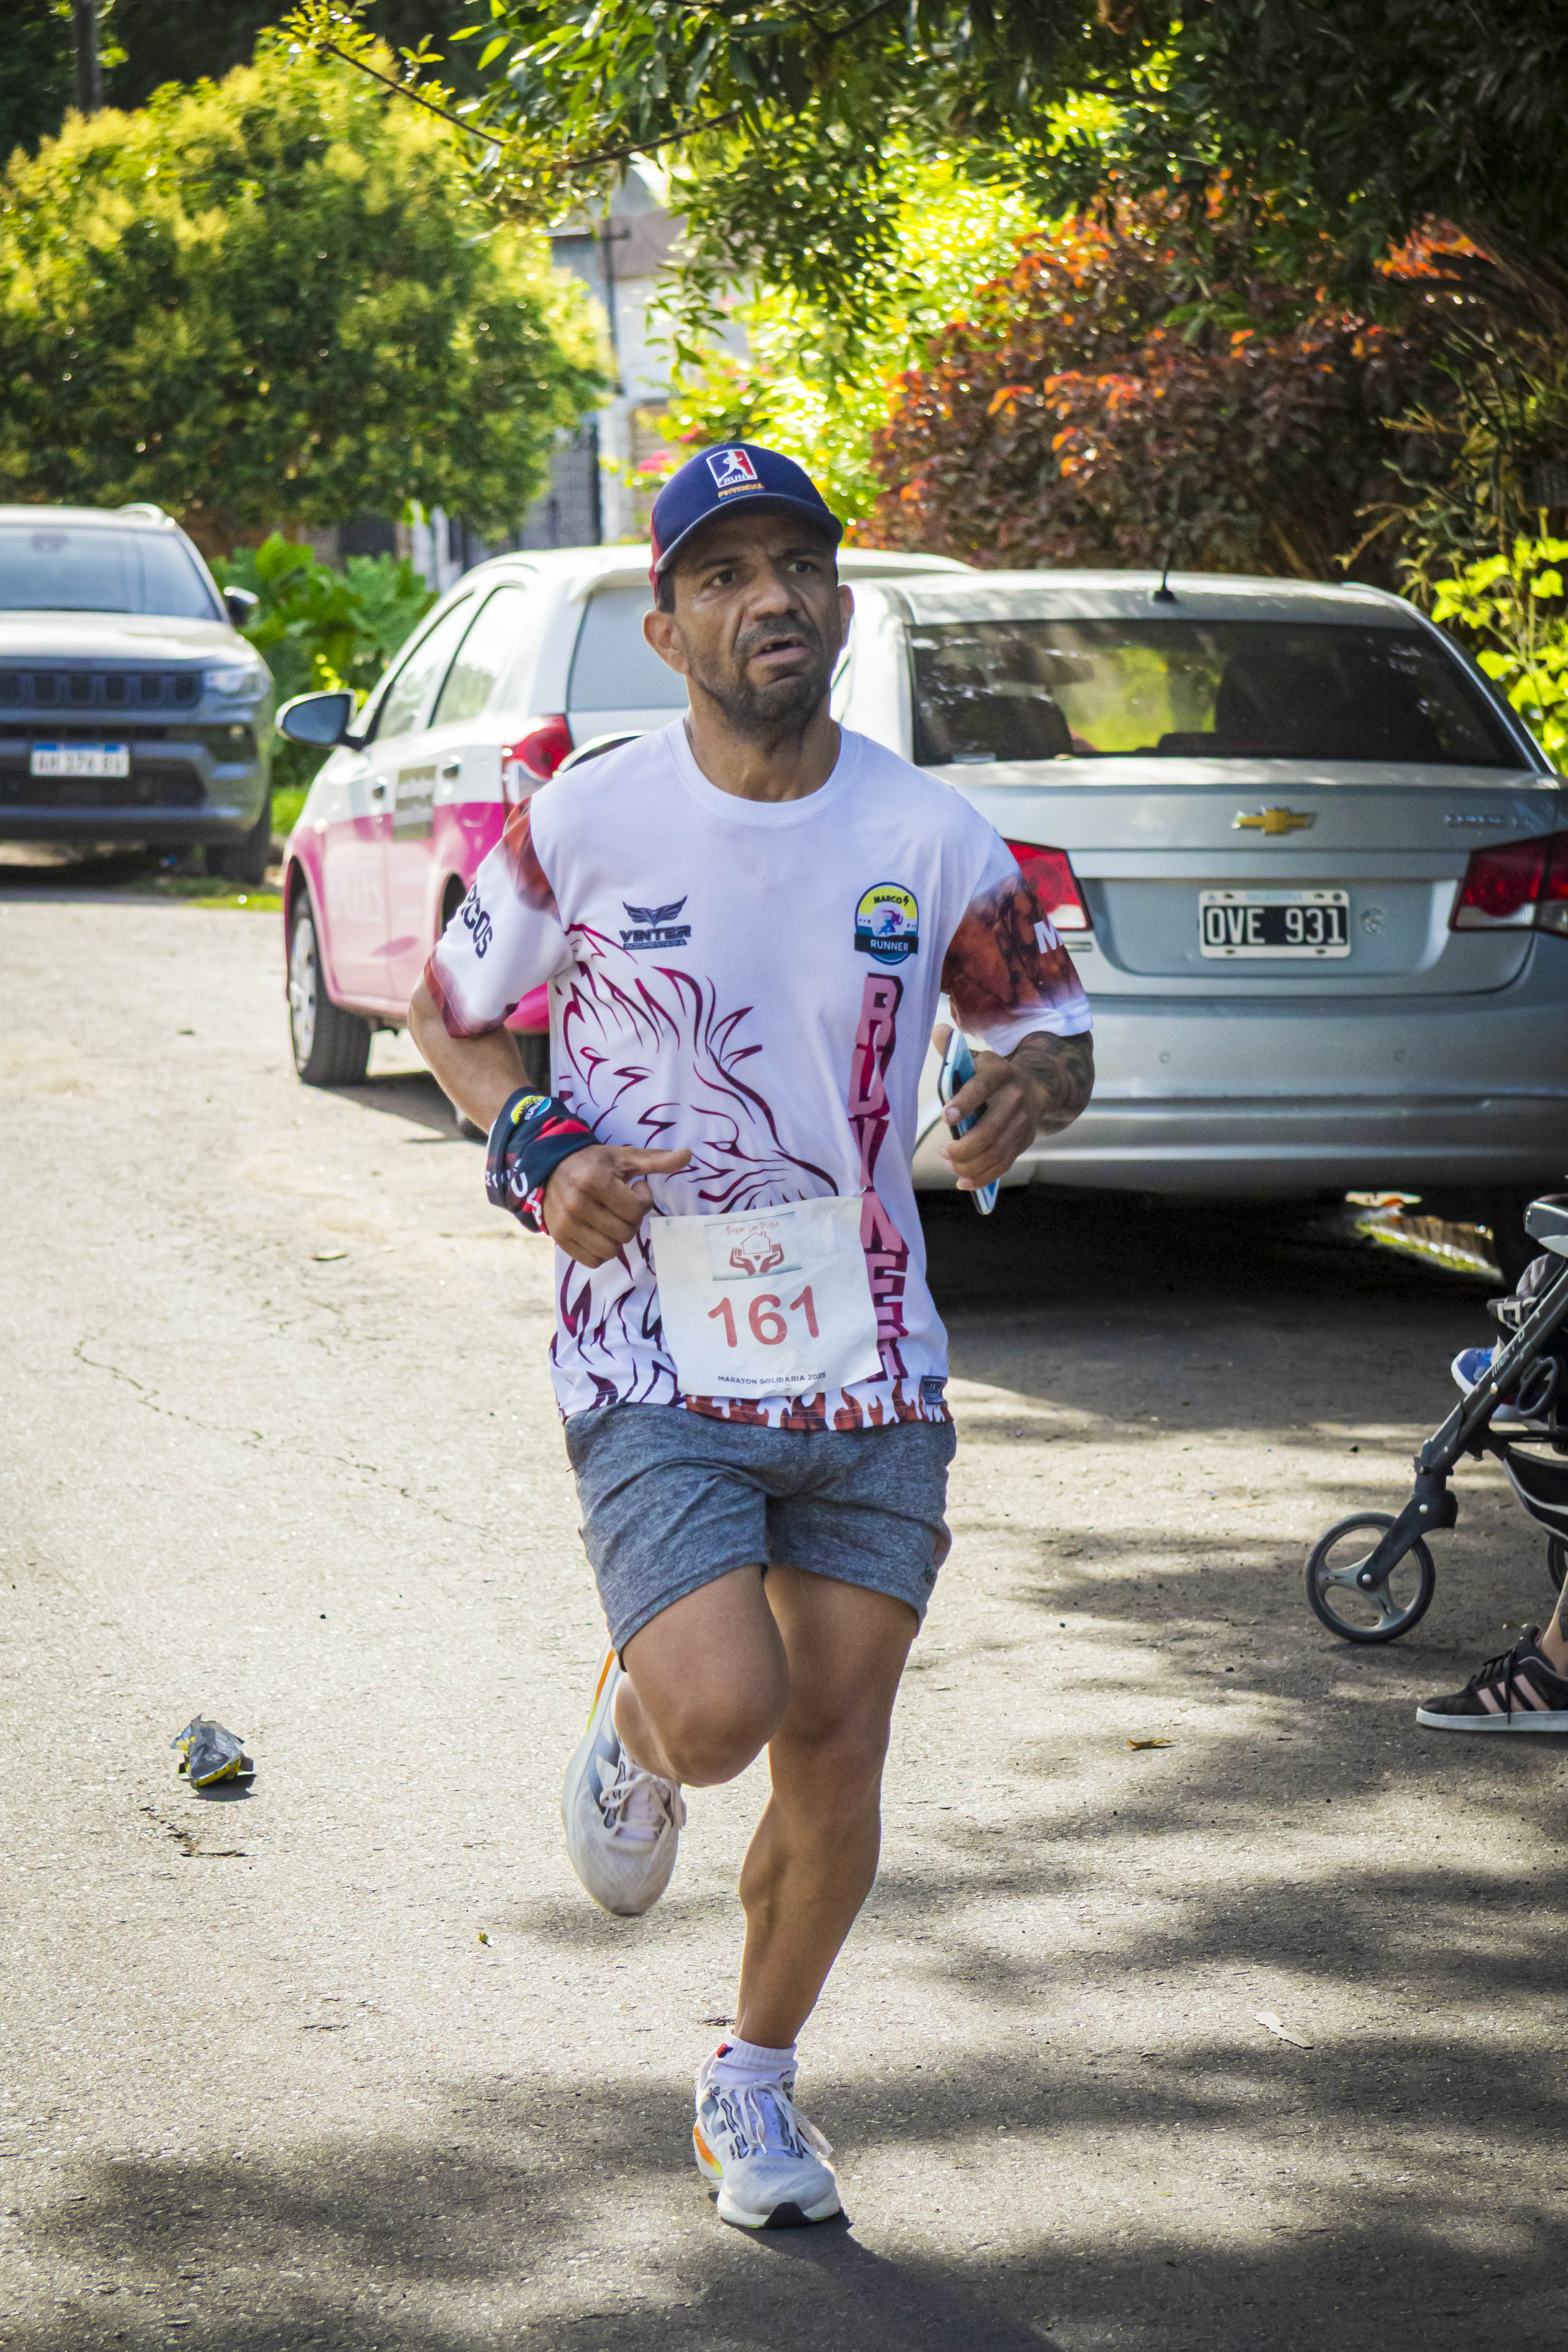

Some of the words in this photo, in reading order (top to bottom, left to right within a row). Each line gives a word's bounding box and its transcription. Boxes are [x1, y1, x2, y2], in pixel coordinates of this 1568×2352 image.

[723, 474, 747, 484] RUN
[619, 925, 691, 943] VINTER
[1206, 908, 1266, 944] OVE
[1285, 908, 1345, 944] 931
[870, 939, 909, 952] RUNNER
[708, 1285, 819, 1348] 161
[718, 1375, 757, 1385] MARATON
[760, 1374, 806, 1385] SOLIDARIA
[807, 1371, 826, 1380] 2025
